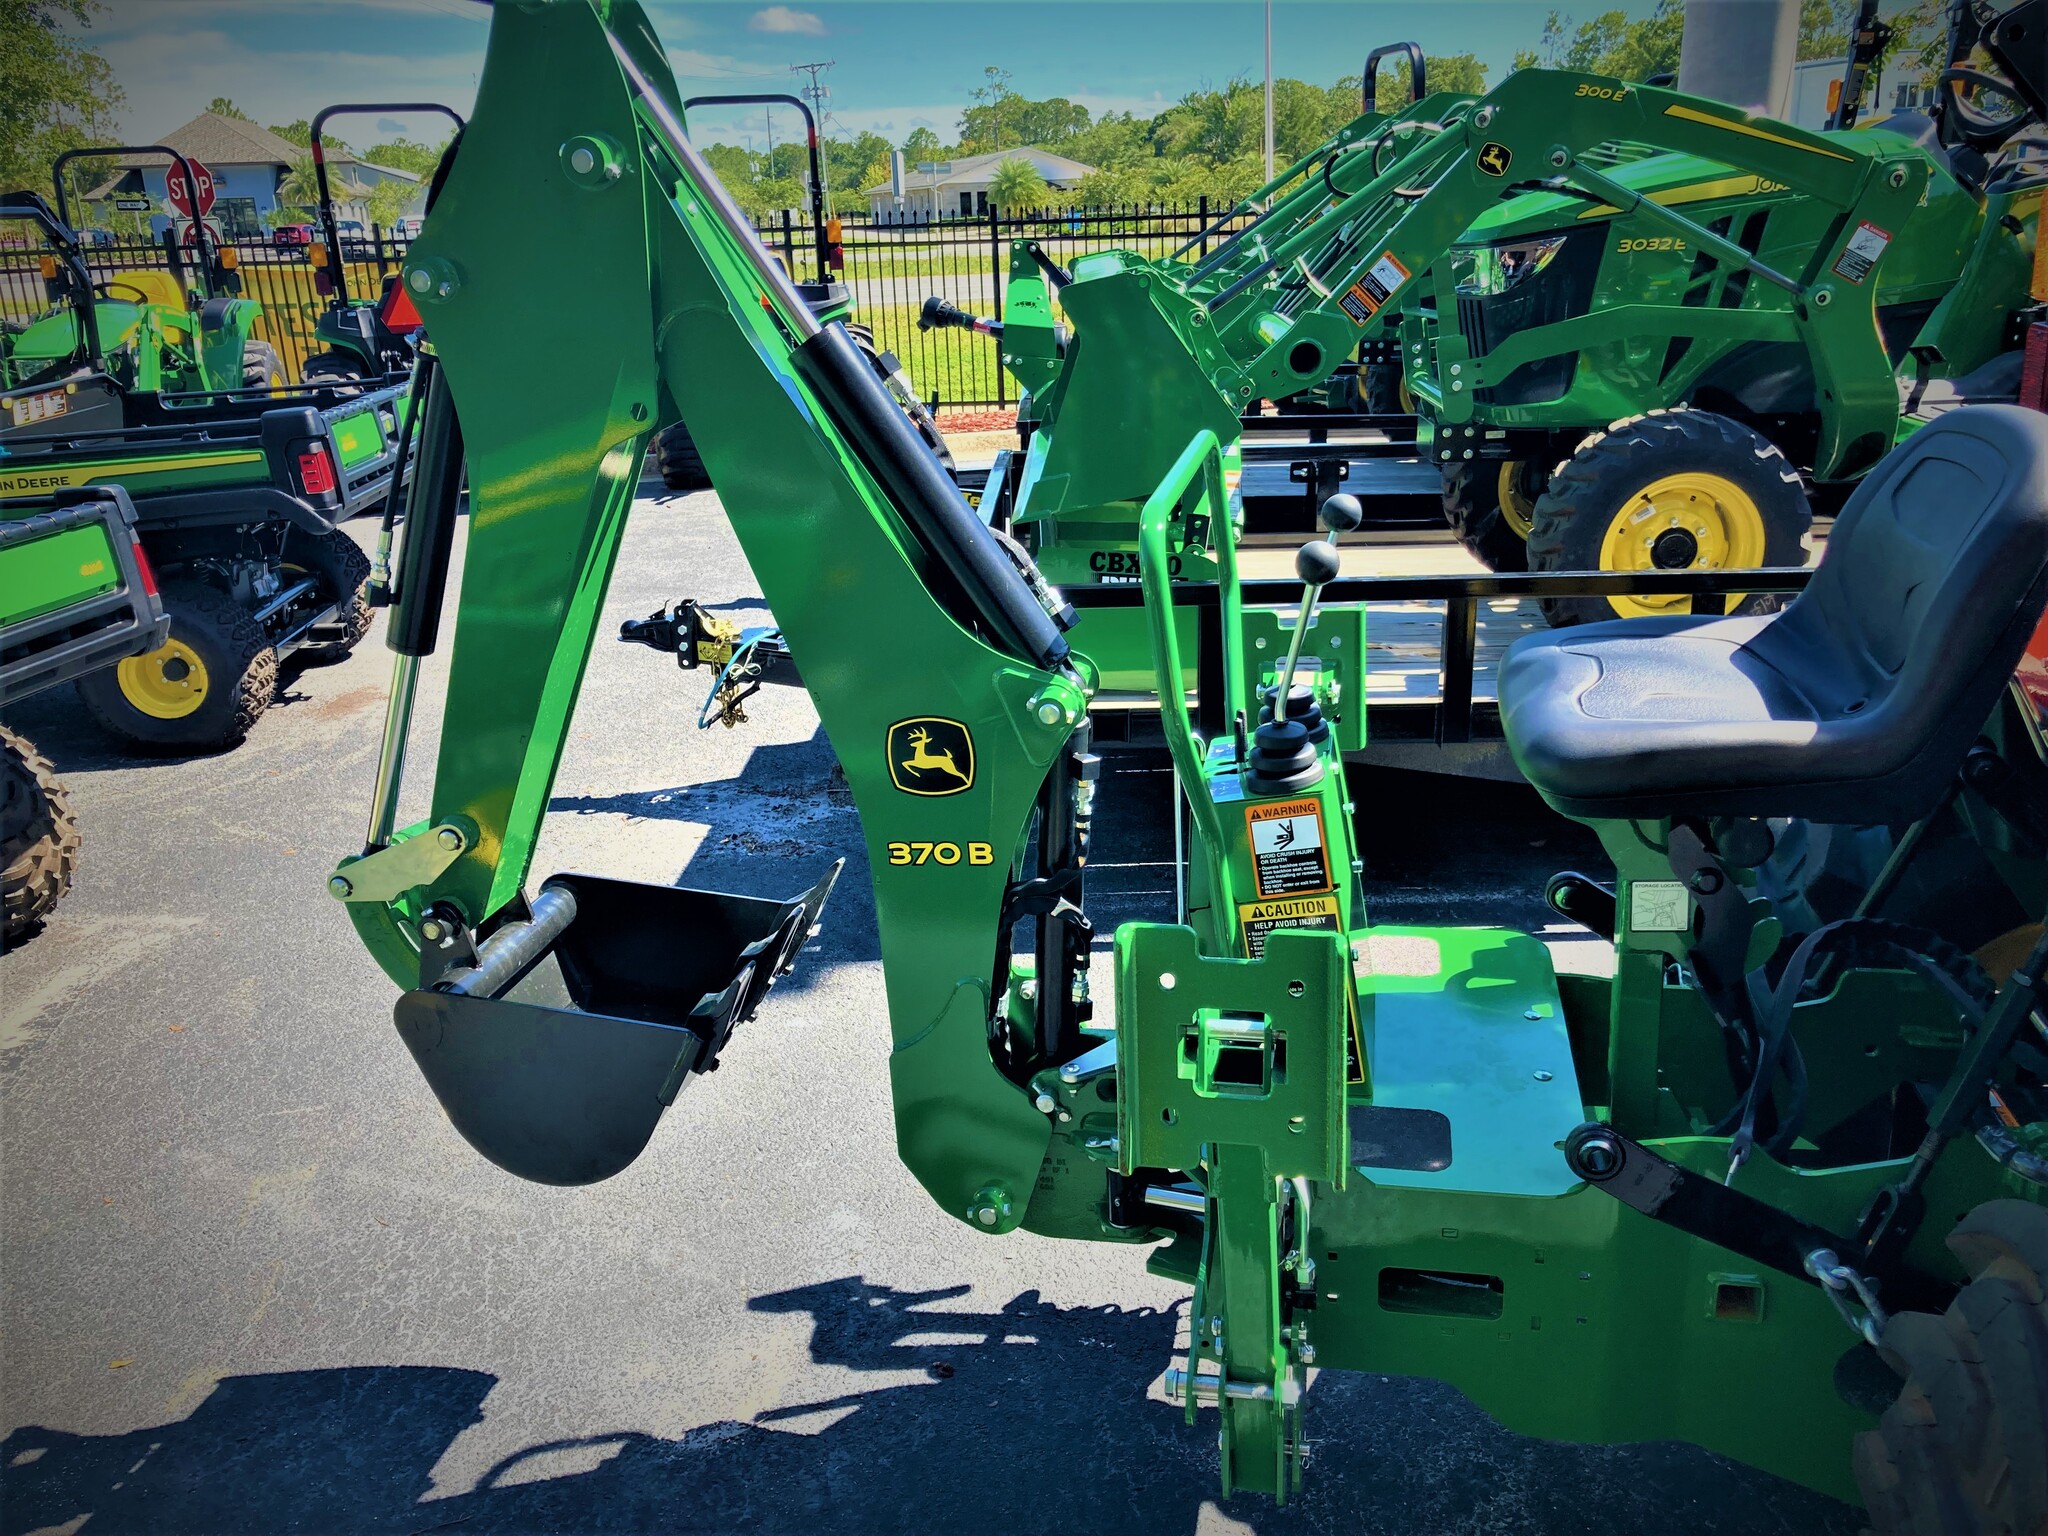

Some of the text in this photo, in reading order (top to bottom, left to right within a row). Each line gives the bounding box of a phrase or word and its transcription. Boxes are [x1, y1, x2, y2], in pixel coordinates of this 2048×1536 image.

[1574, 83, 1613, 99] 300
[16, 476, 71, 490] DEERE
[1089, 551, 1183, 576] CBX0
[1262, 803, 1316, 818] WARNING
[888, 841, 996, 866] 370 B
[1296, 848, 1315, 856] INJURY
[1265, 900, 1327, 917] CAUTION
[1254, 916, 1327, 930] HELP AVOID INJURY
